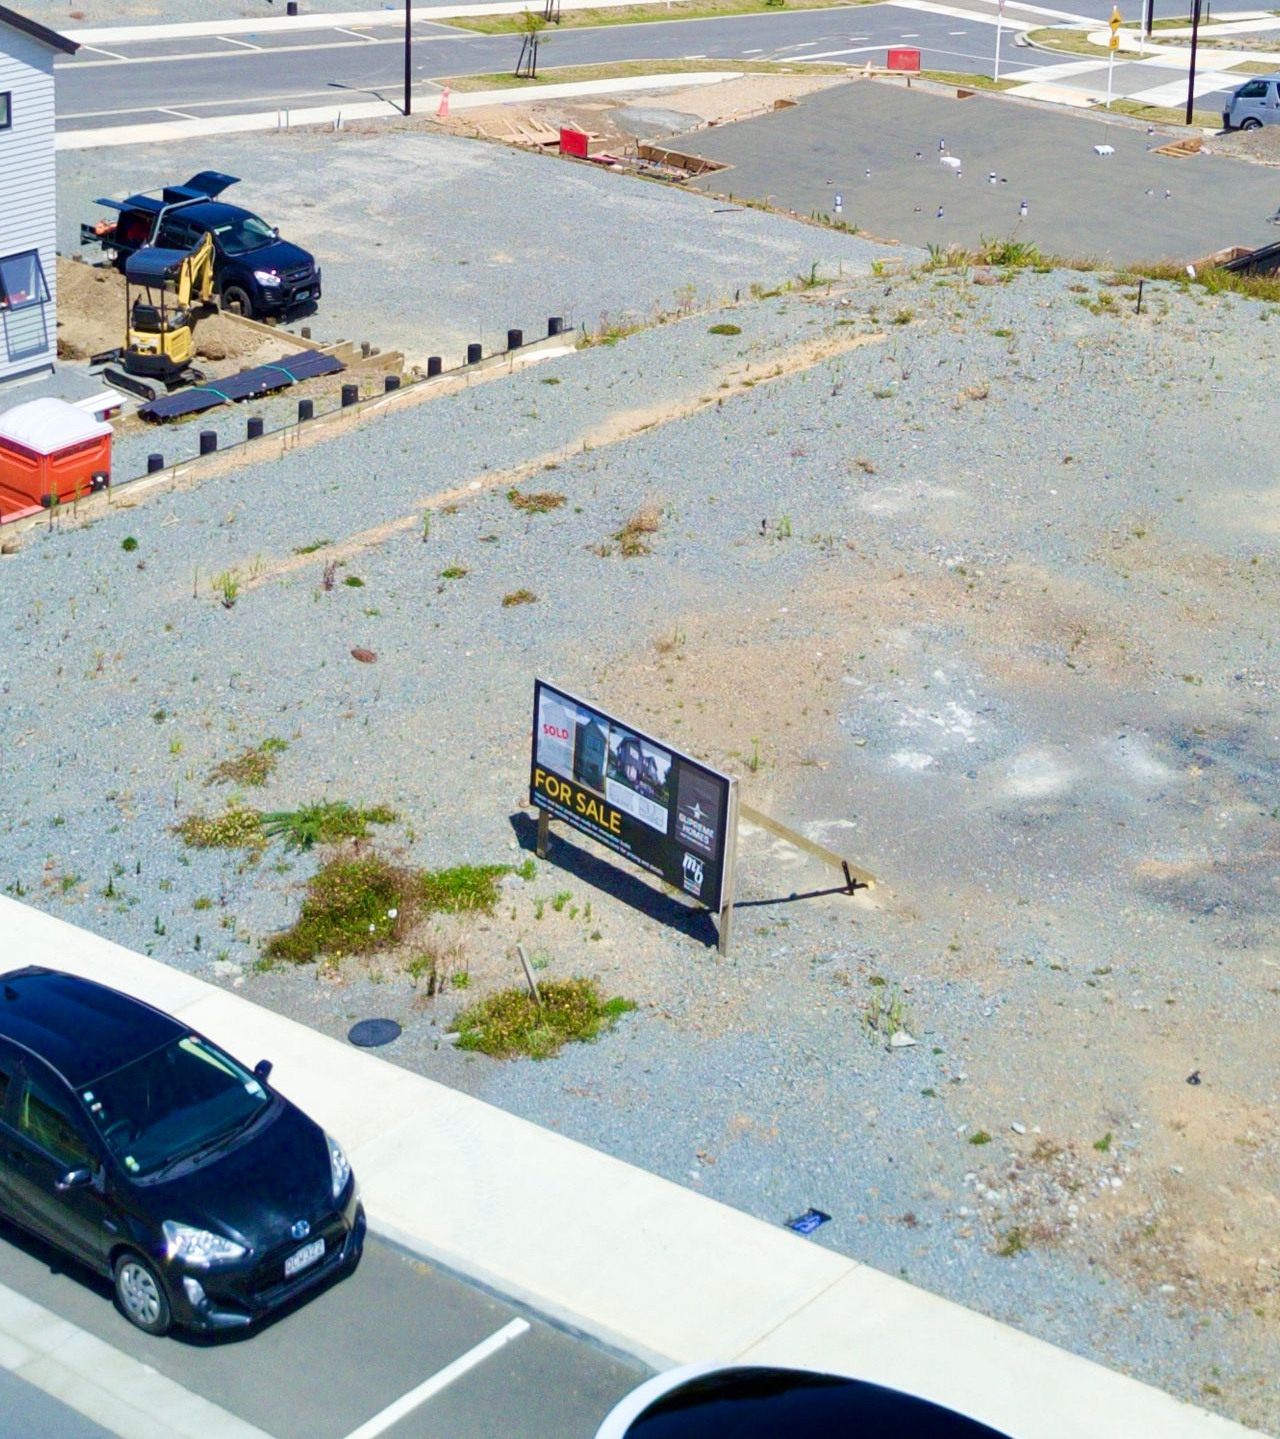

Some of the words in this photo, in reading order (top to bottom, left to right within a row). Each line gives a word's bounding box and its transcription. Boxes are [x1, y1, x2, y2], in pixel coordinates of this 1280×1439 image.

[543, 723, 569, 739] SOLD
[534, 768, 572, 806] FOR
[575, 792, 622, 834] SALE
